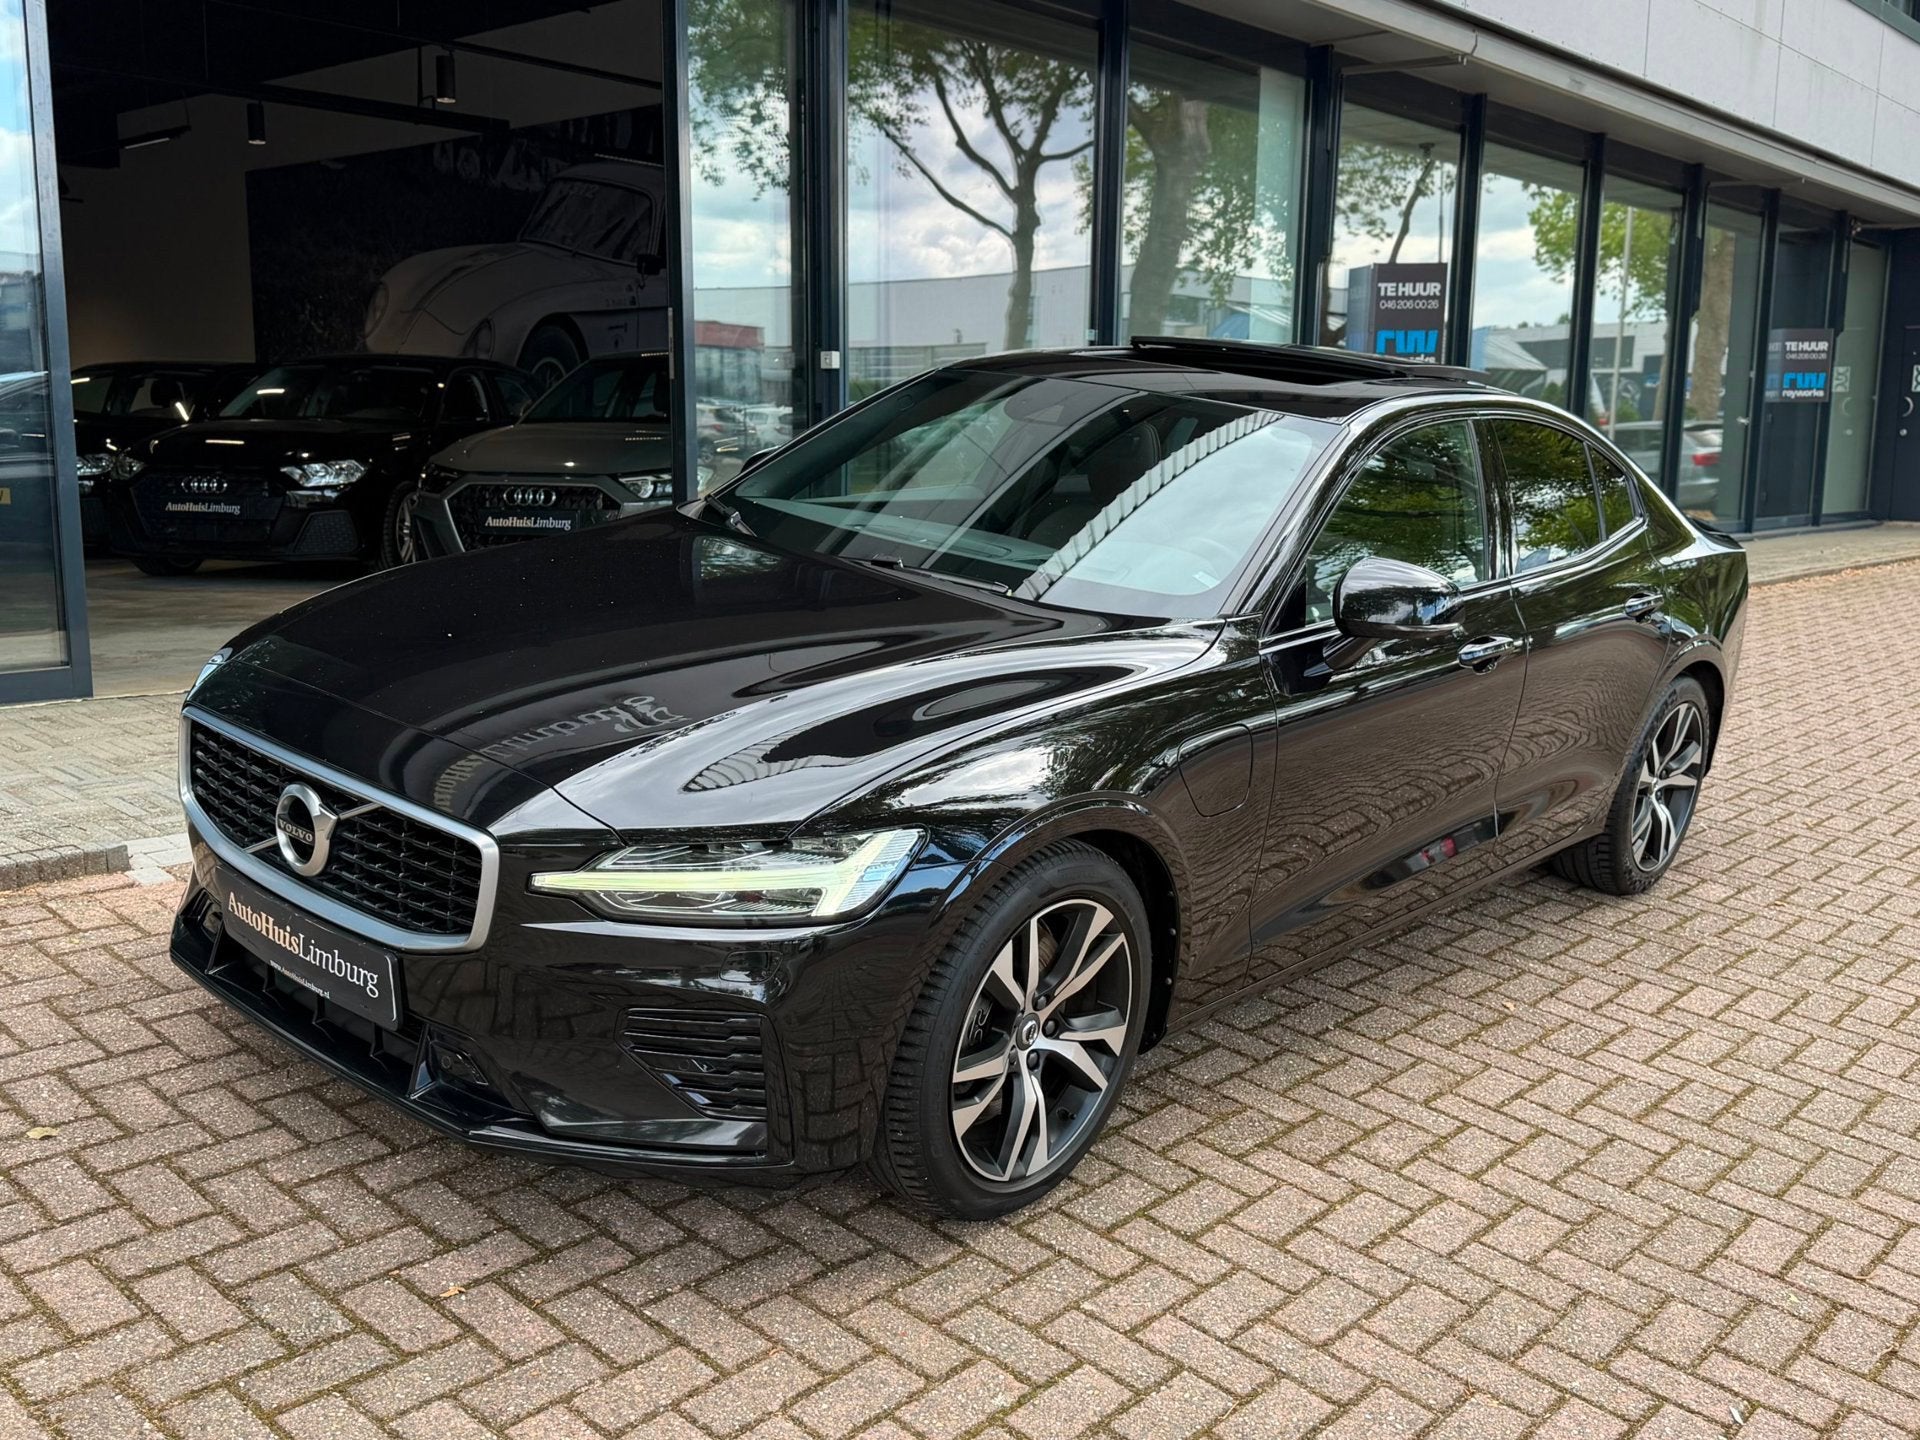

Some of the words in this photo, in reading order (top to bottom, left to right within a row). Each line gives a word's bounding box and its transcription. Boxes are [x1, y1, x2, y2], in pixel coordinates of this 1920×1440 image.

[1377, 282, 1397, 297] TE
[1398, 282, 1442, 297] HUUR
[1379, 299, 1396, 309] 046
[1397, 299, 1414, 309] 206
[1415, 299, 1427, 309] 00
[1428, 299, 1439, 309] 26
[1784, 341, 1798, 352] TE
[1798, 341, 1829, 352] HUUR
[165, 501, 241, 516] AutoHuisLimburg
[485, 516, 572, 531] AutoHuisLimburg
[279, 818, 314, 842] VOLVO
[228, 891, 380, 998] AutoHuisLimburg
